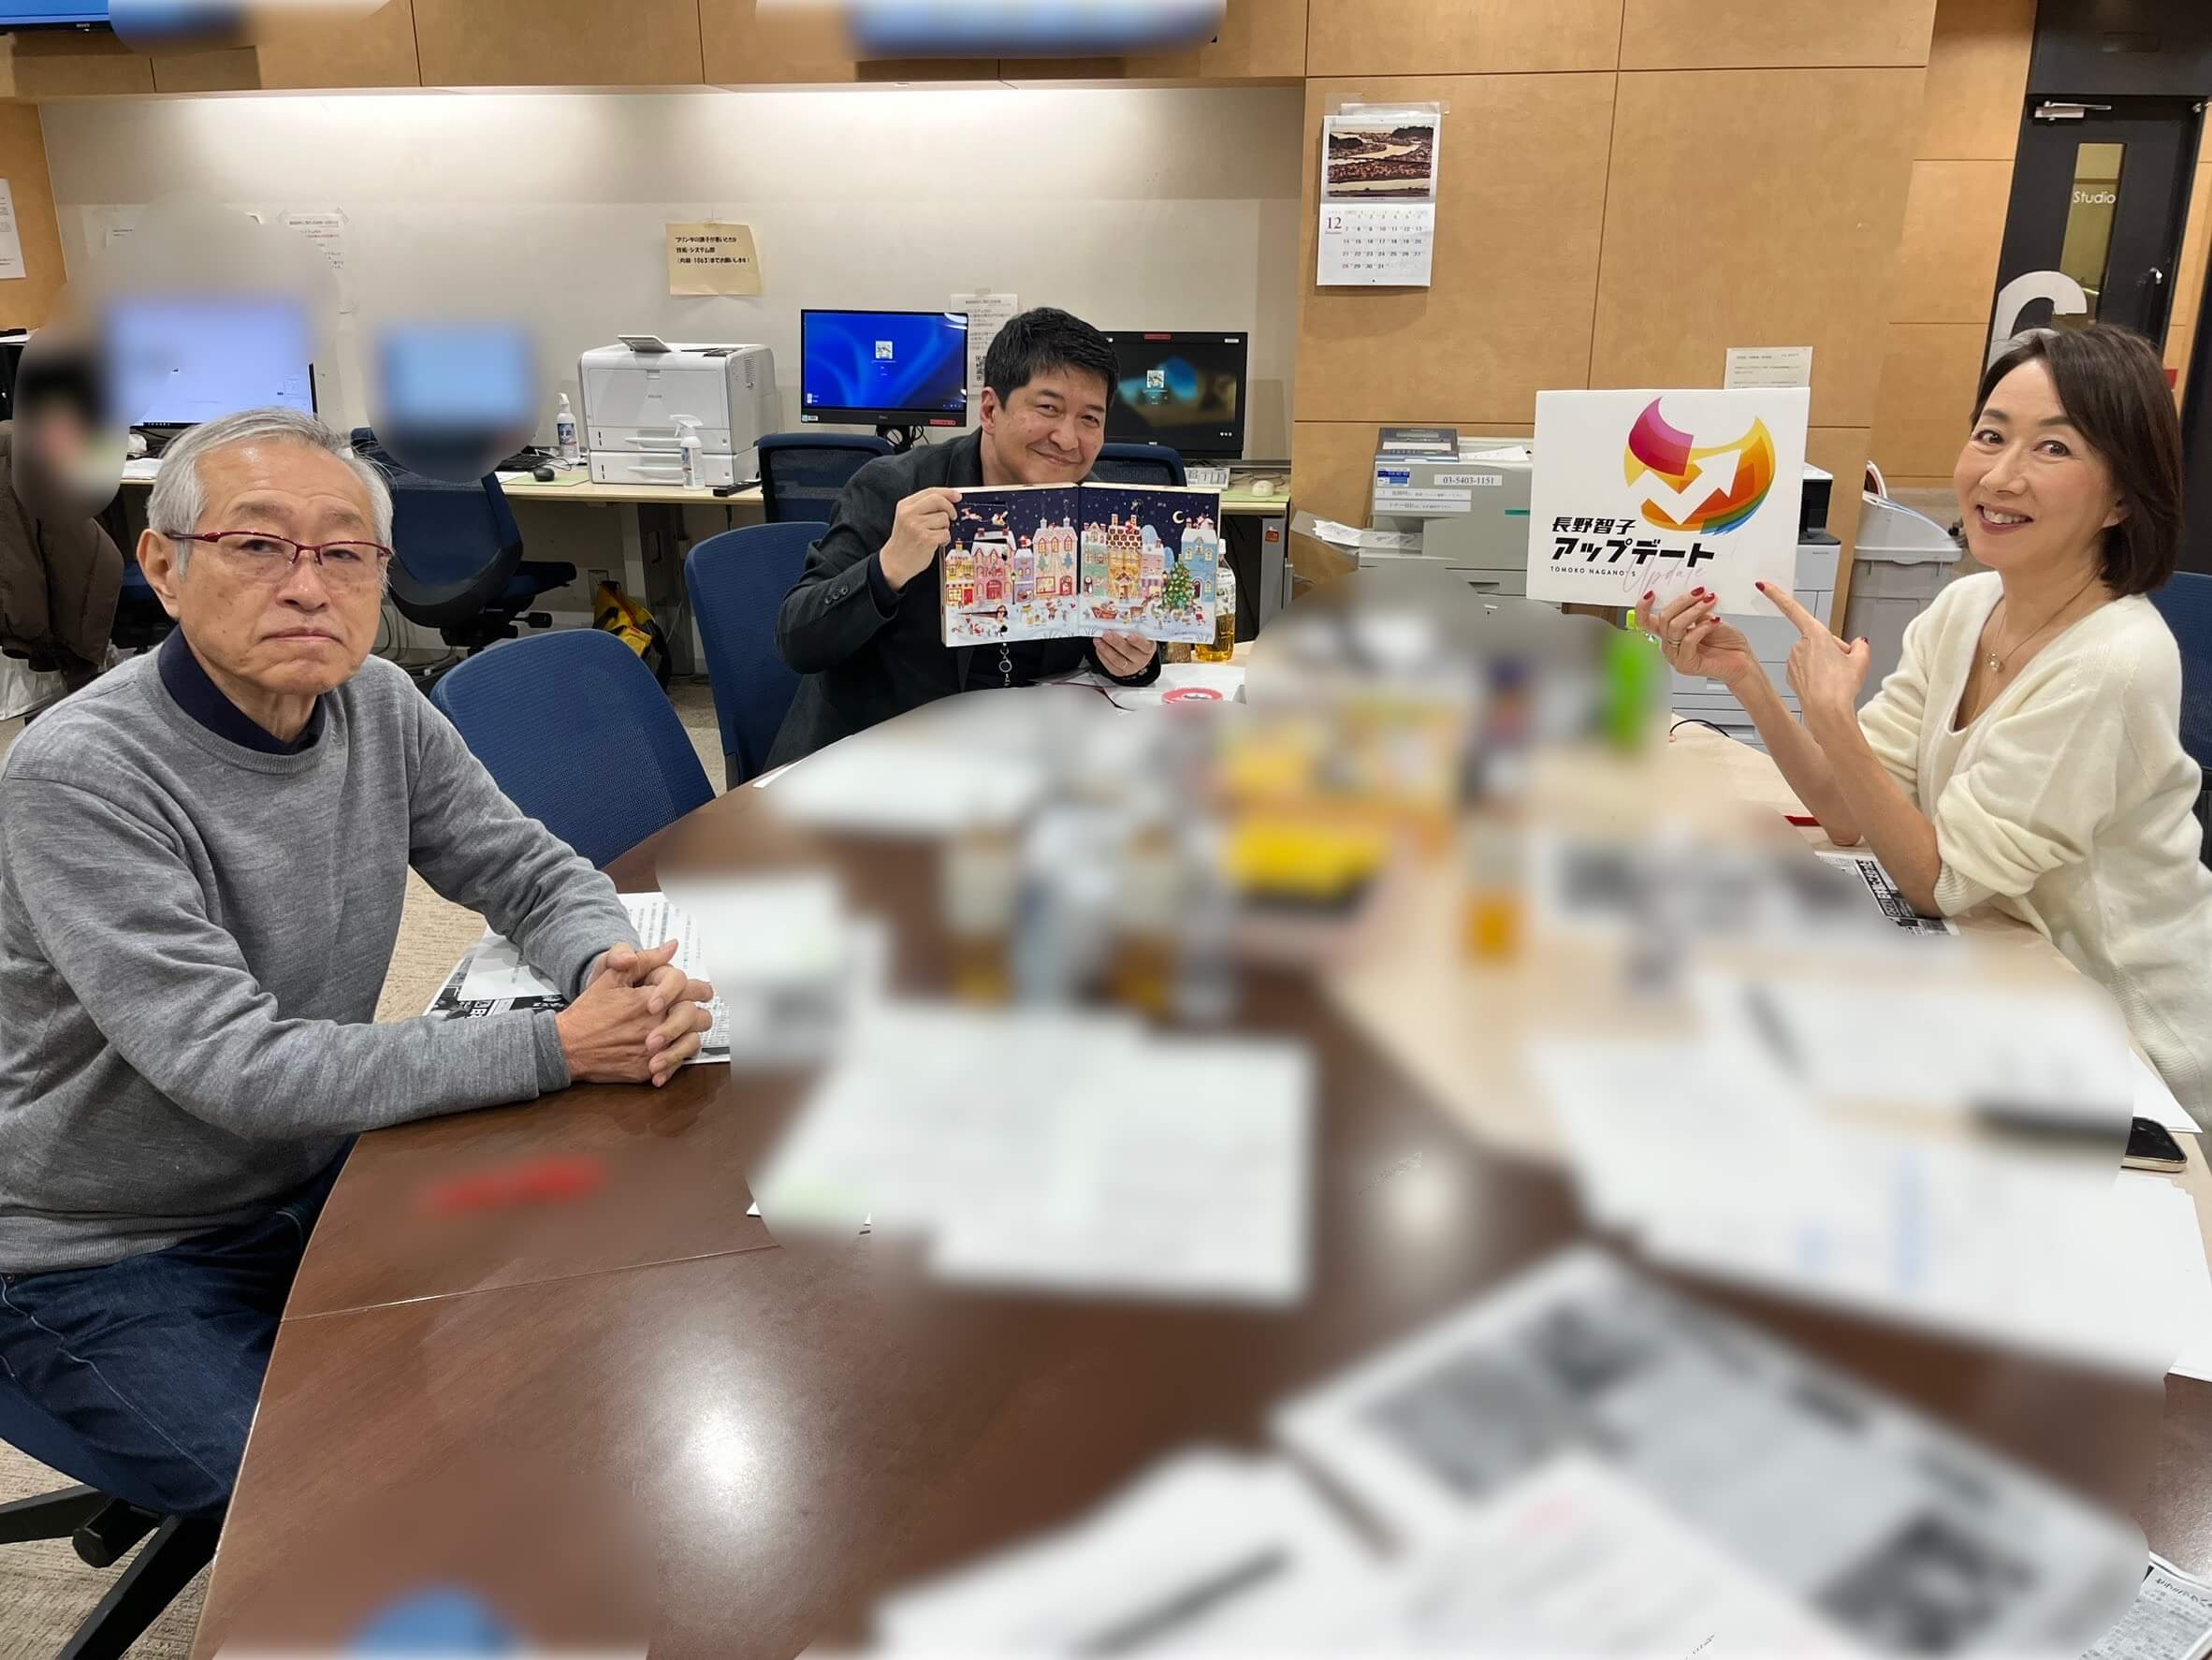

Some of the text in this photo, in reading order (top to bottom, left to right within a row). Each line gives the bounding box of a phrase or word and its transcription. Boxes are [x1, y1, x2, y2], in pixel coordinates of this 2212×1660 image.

[2073, 190, 2117, 204] Studio
[1328, 216, 1342, 229] 12
[1442, 475, 1494, 486] 03-5403-1151
[1551, 516, 1637, 535] 長野智子
[1551, 536, 1715, 569] アップデート
[1550, 565, 1586, 575] TOMOKO
